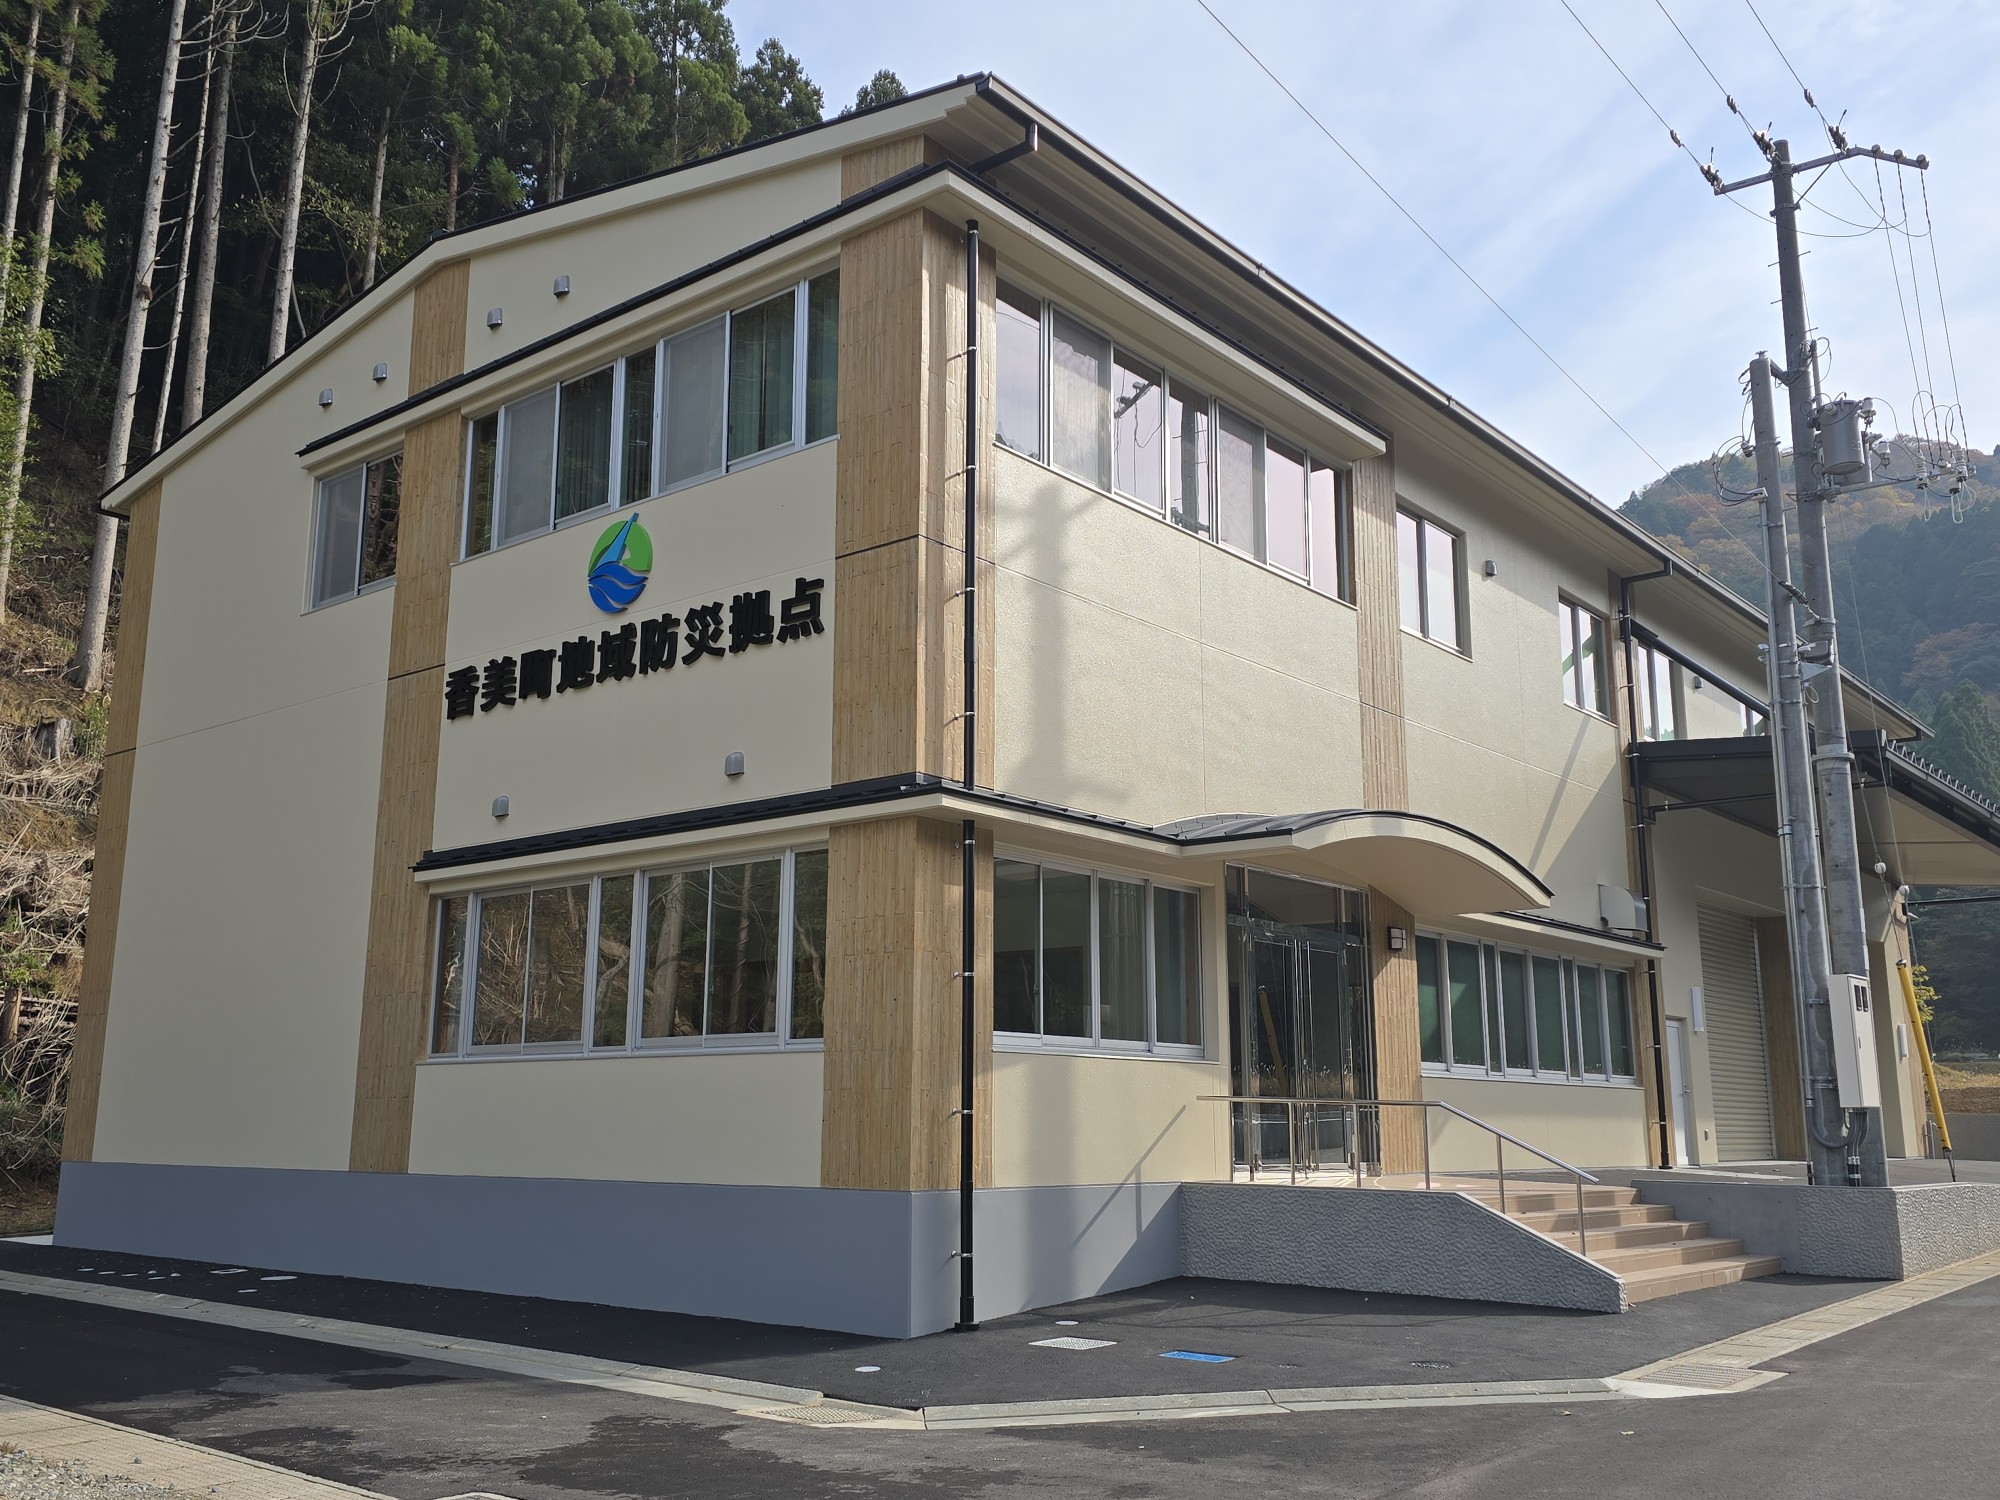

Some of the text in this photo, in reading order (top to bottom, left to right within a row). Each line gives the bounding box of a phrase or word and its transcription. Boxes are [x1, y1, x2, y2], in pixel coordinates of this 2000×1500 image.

[445, 577, 825, 720] 香美町地域防災拠点
